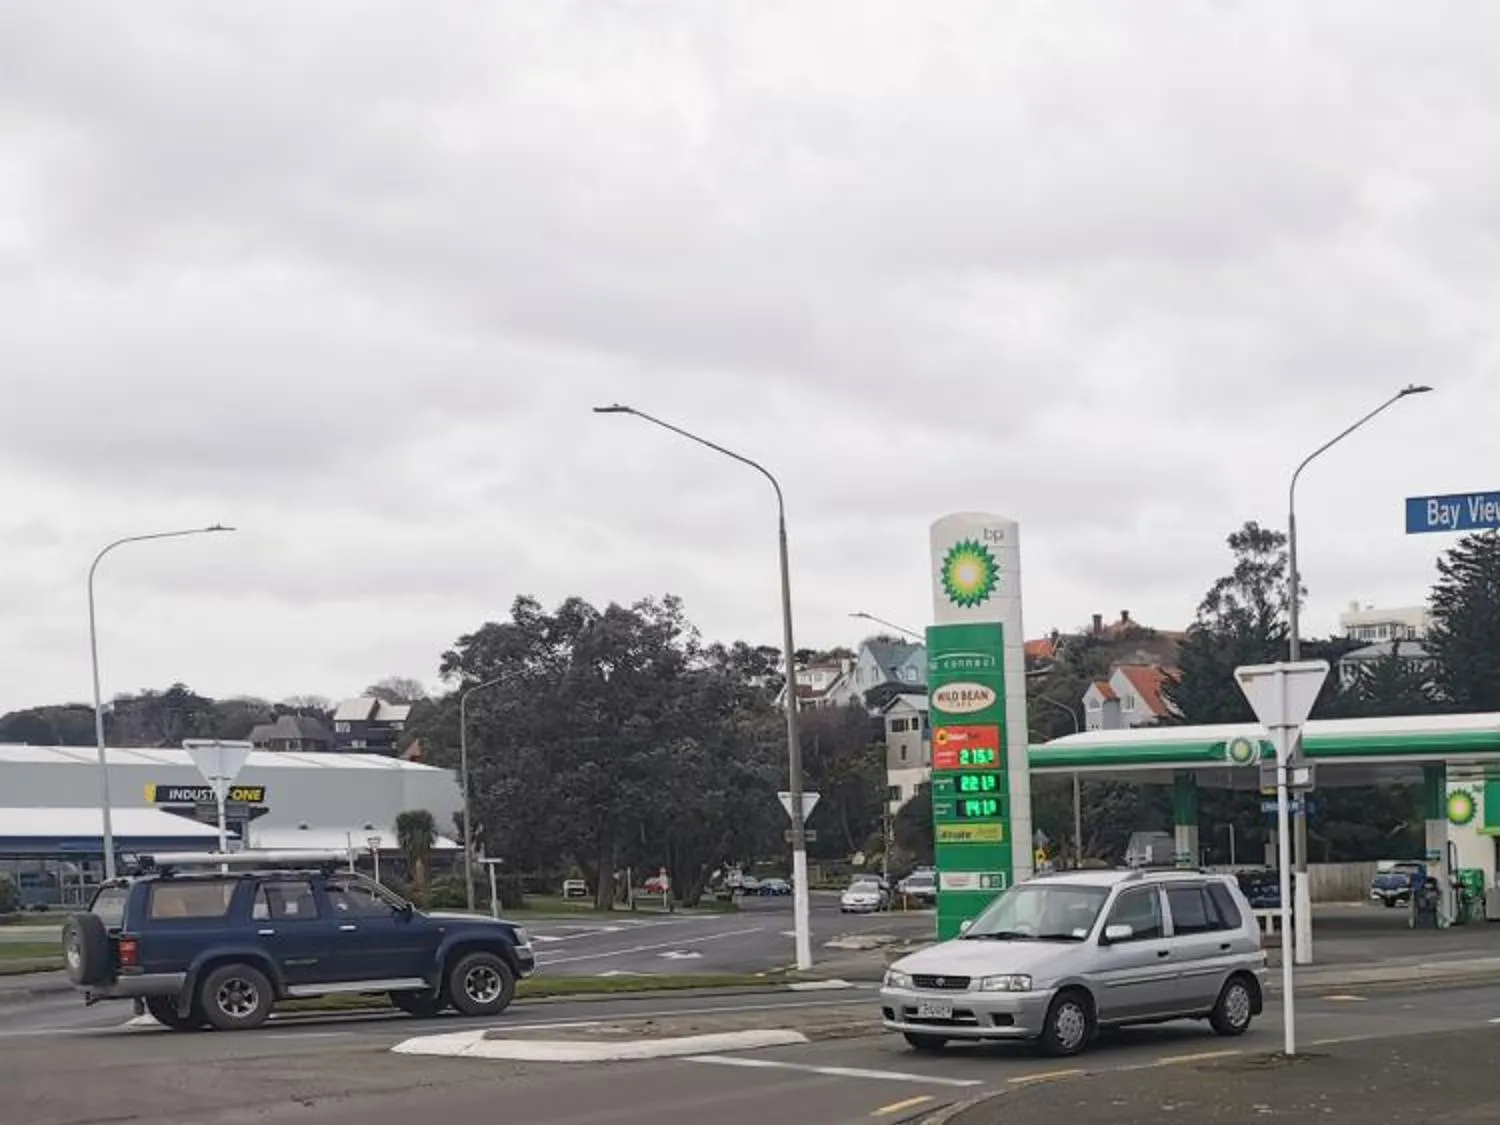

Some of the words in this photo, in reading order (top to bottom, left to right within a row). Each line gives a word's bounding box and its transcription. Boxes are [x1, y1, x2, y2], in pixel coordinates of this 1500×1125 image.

[1427, 499, 1461, 528] Bay
[983, 527, 1004, 544] bp
[232, 788, 263, 801] ONE
